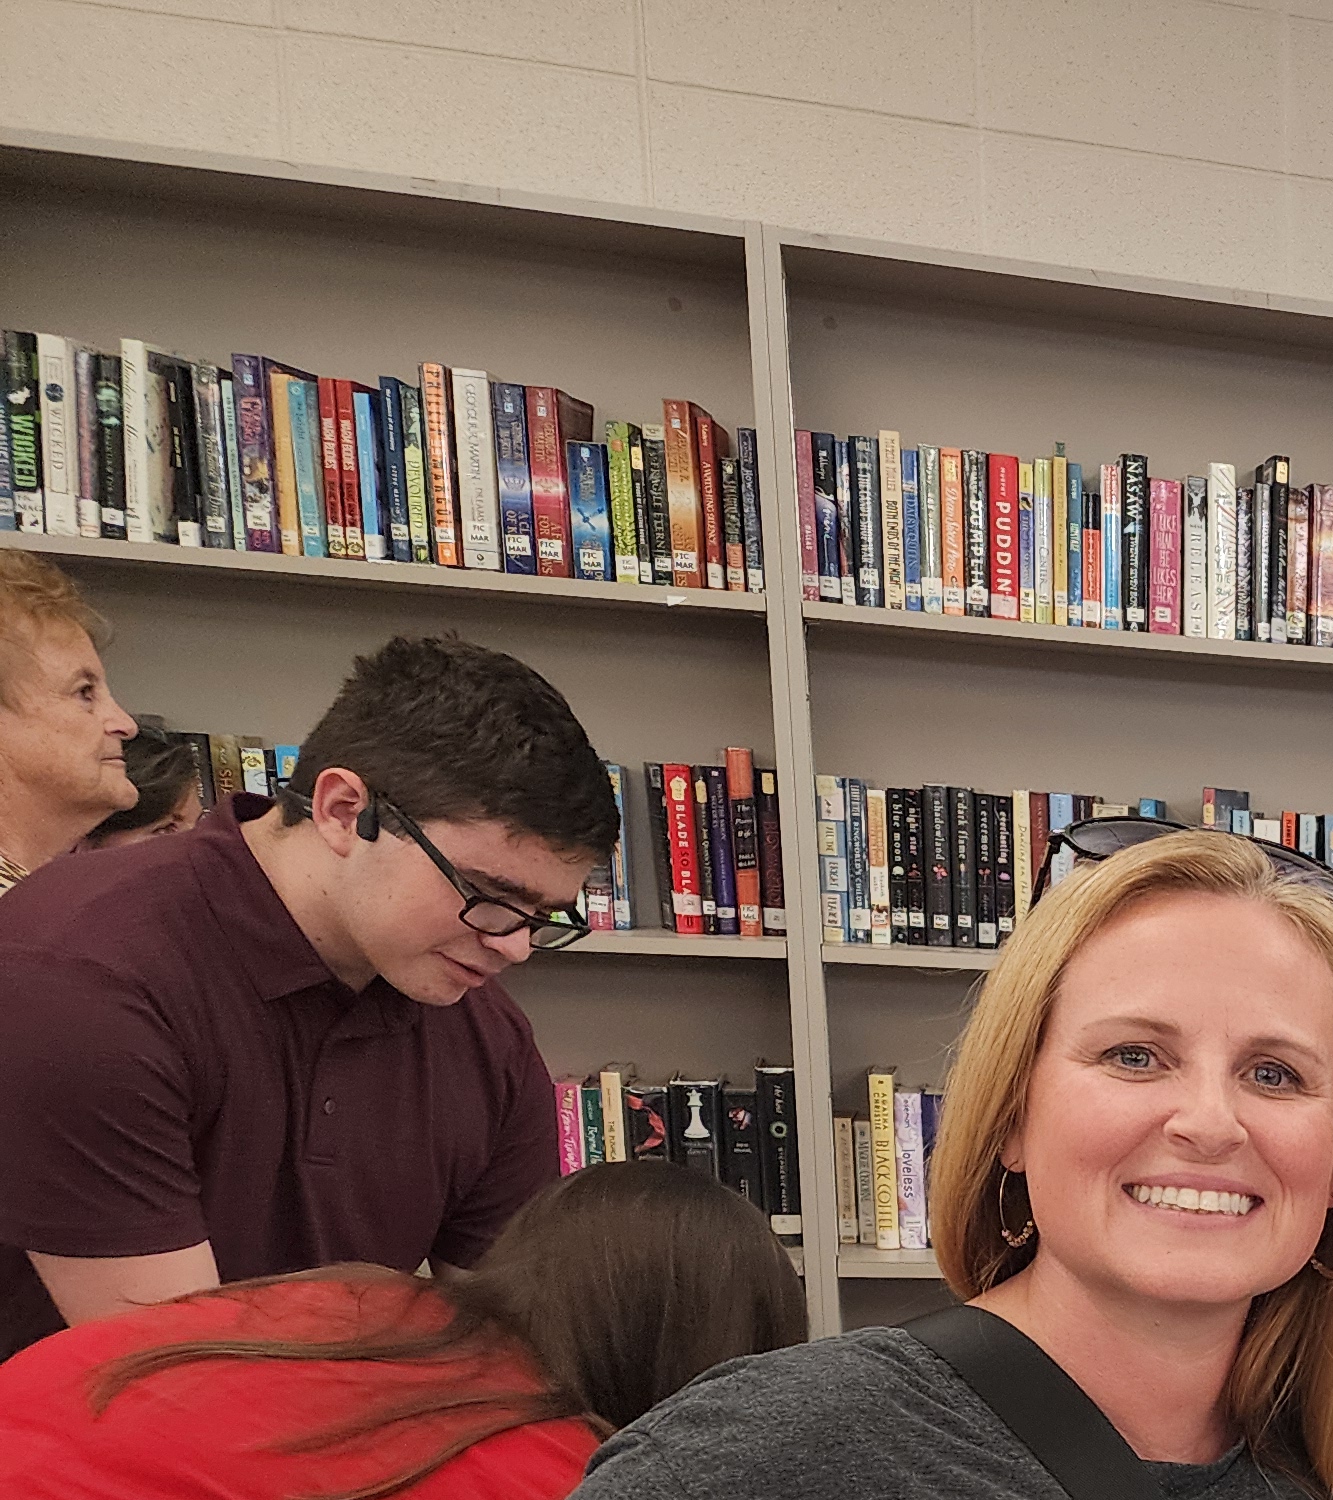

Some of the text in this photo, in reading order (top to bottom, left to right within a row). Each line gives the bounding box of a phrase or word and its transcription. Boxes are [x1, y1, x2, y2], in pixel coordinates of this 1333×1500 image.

[1126, 459, 1141, 518] NASAW
[886, 499, 899, 519] BOTH
[470, 533, 490, 543] MAR
[540, 540, 555, 549] FIC
[887, 520, 899, 541] ENDS
[540, 549, 560, 559] MAR
[582, 551, 597, 560] FIC
[582, 559, 604, 569] MAR
[675, 562, 695, 571] MAR
[888, 553, 900, 567] THE
[676, 804, 689, 867] BLADE SO
[892, 803, 904, 862] blue moon
[906, 807, 919, 856] night star
[932, 800, 946, 861] shadowland
[957, 801, 969, 860] dark flame
[979, 810, 991, 862] evermore
[854, 877, 863, 910] CHILDR
[873, 1092, 882, 1130] CHRISTIE
[880, 1092, 889, 1130] AGATHA
[875, 1140, 893, 1231] BLACK COFFEE
[901, 1149, 915, 1199] loveless
